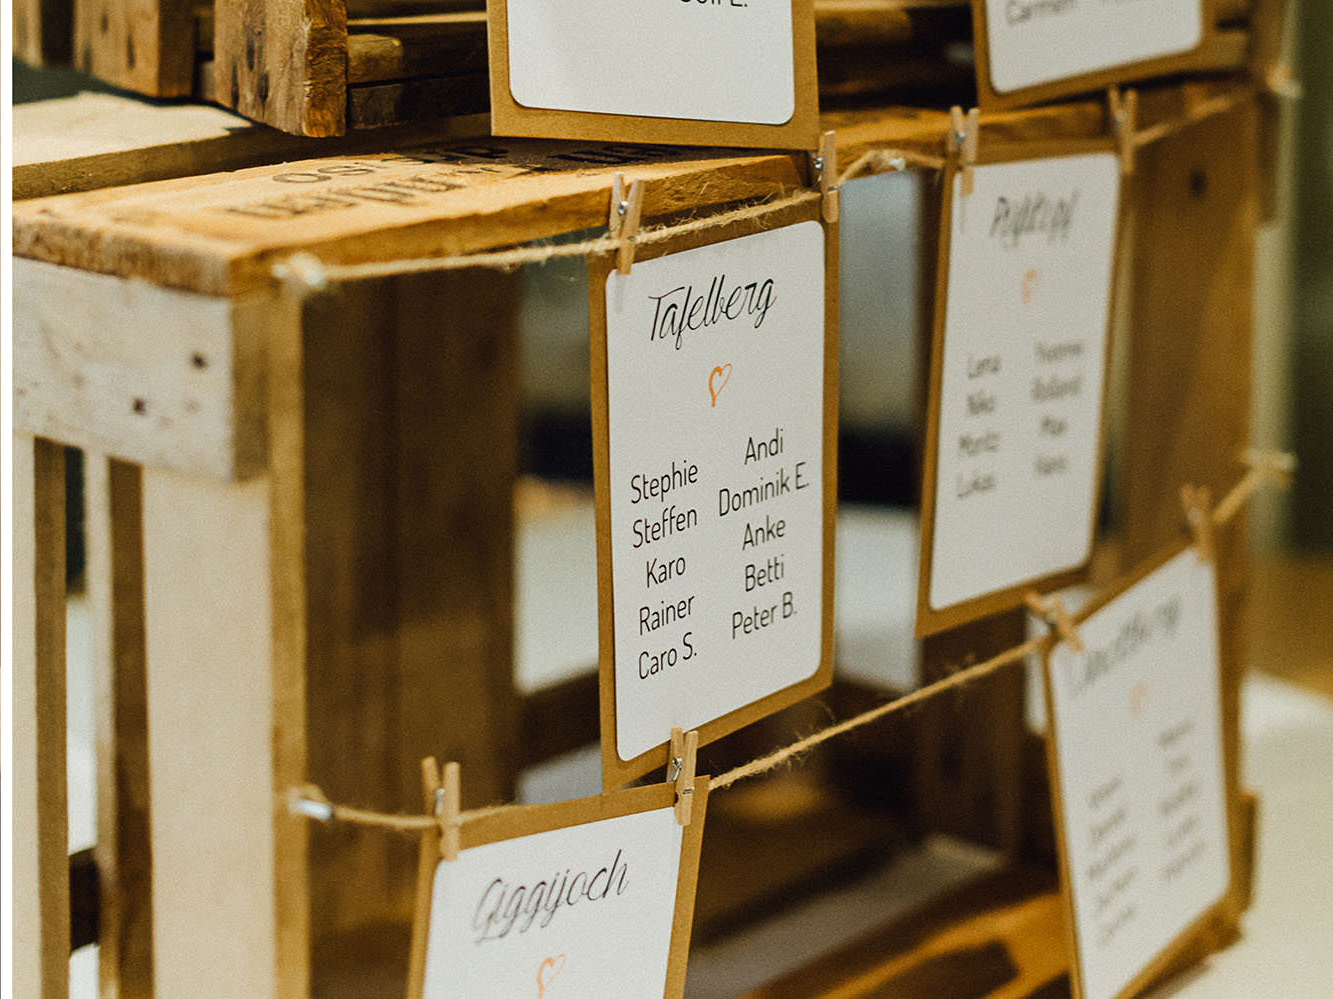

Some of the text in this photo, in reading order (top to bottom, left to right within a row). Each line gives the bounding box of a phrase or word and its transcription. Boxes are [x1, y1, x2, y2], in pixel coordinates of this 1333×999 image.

[649, 274, 776, 350] Tafelberg
[744, 428, 783, 465] Andi
[631, 460, 698, 504] Stephie
[719, 462, 809, 516] Dominik E.
[633, 505, 697, 548] Steffen
[742, 515, 785, 550] Anke
[647, 557, 685, 588] Karo
[745, 554, 783, 592] Betti
[640, 596, 694, 635] Rainer
[733, 592, 797, 639] Peter B.
[639, 632, 697, 679] Caro S.
